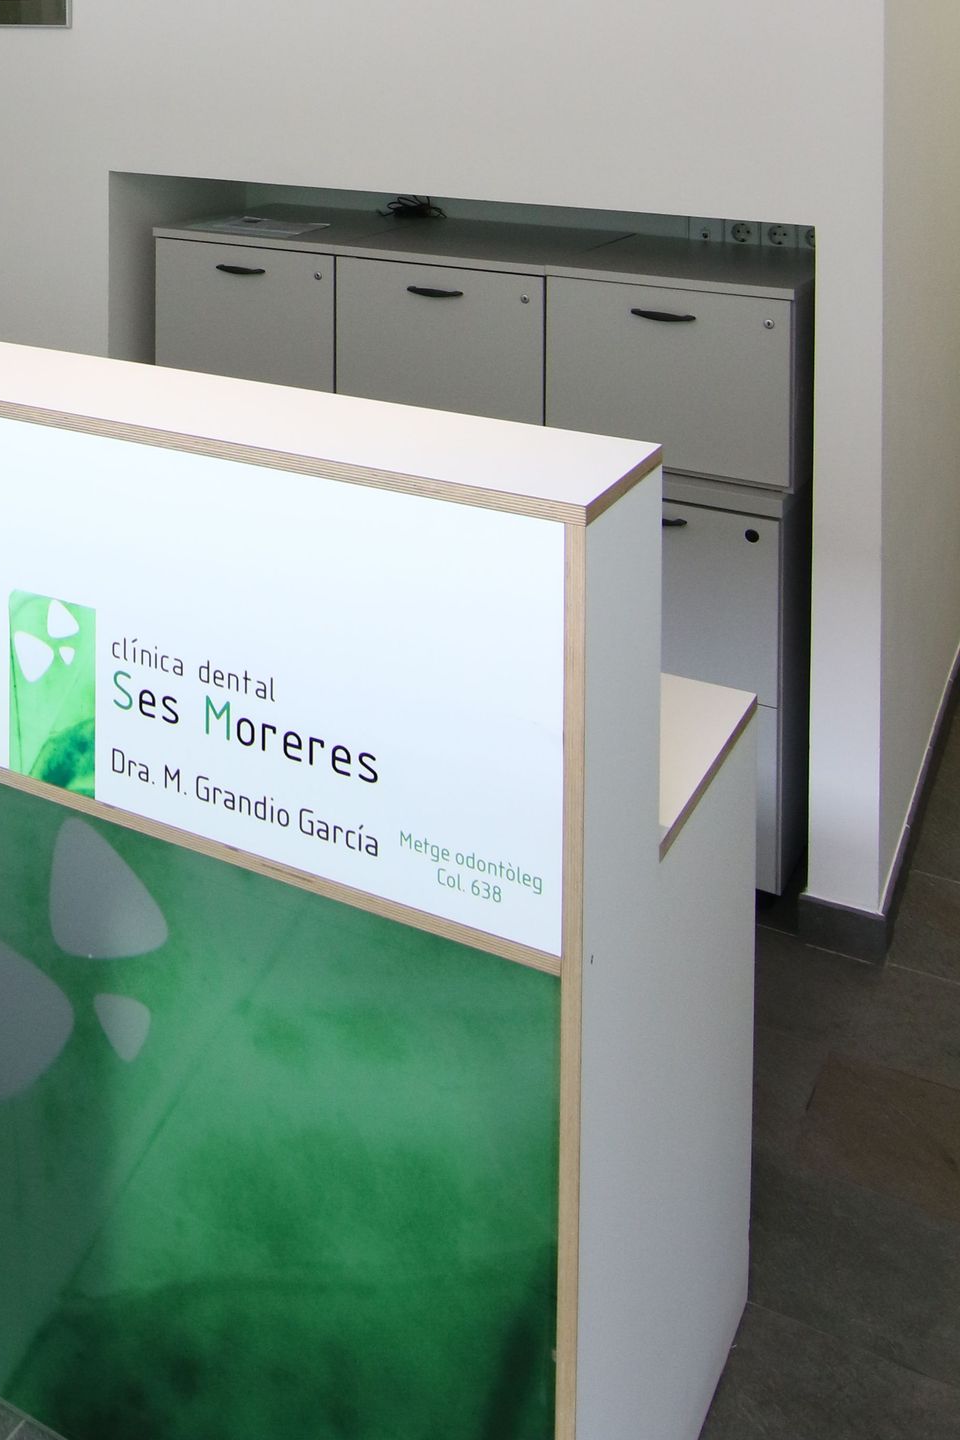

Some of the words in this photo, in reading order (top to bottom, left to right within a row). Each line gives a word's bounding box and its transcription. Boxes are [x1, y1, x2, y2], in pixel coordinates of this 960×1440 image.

[111, 637, 184, 677] clínica
[198, 659, 276, 702] dental
[112, 670, 180, 724] Ses
[204, 695, 380, 784] Moreres
[111, 747, 156, 785] Dra.
[163, 763, 188, 796] M.
[195, 775, 290, 828] Grandio
[298, 809, 380, 858] García
[399, 829, 450, 864] Metge
[455, 851, 544, 895] odontòleg
[436, 867, 466, 894] Col.
[470, 876, 503, 904] 638
